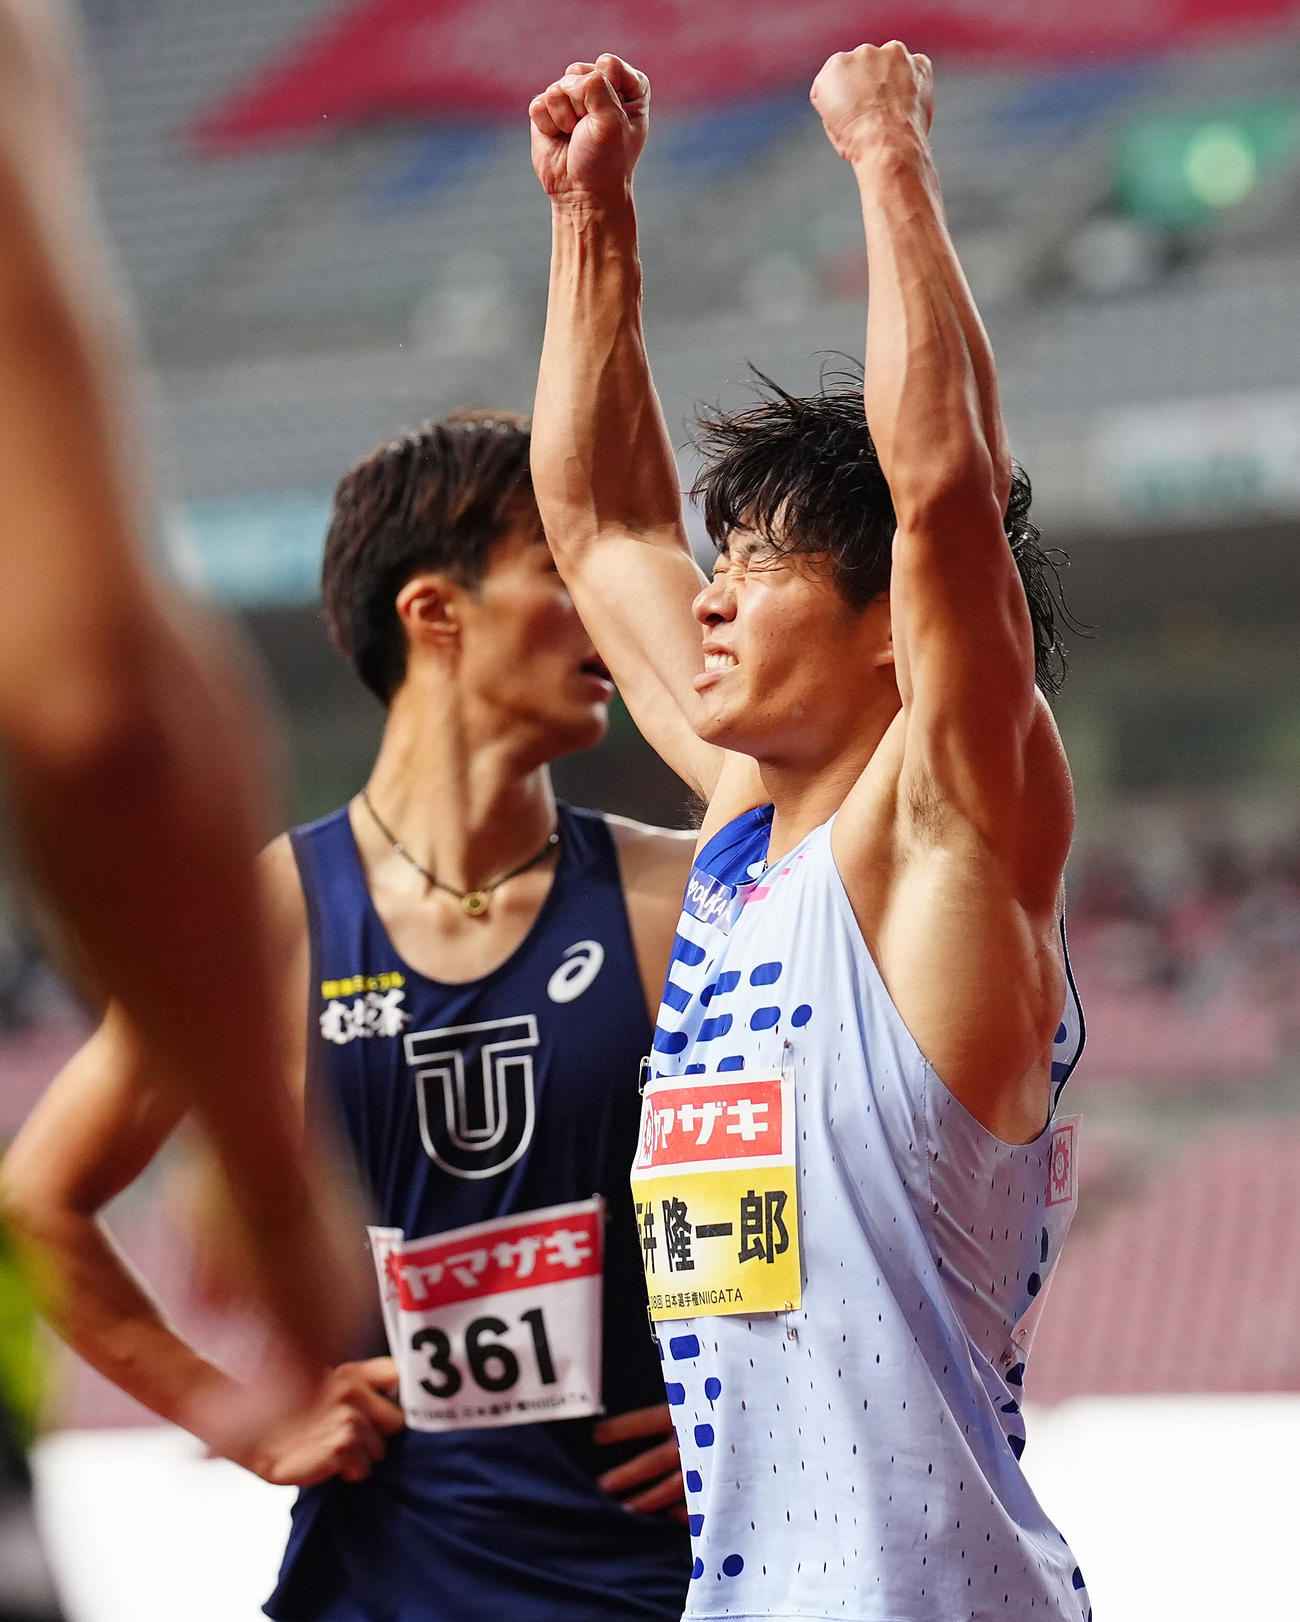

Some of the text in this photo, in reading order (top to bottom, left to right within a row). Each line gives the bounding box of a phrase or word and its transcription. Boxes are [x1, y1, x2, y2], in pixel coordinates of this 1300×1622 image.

[402, 1229, 593, 1300] ヤマザキ
[411, 1307, 557, 1399] 361
